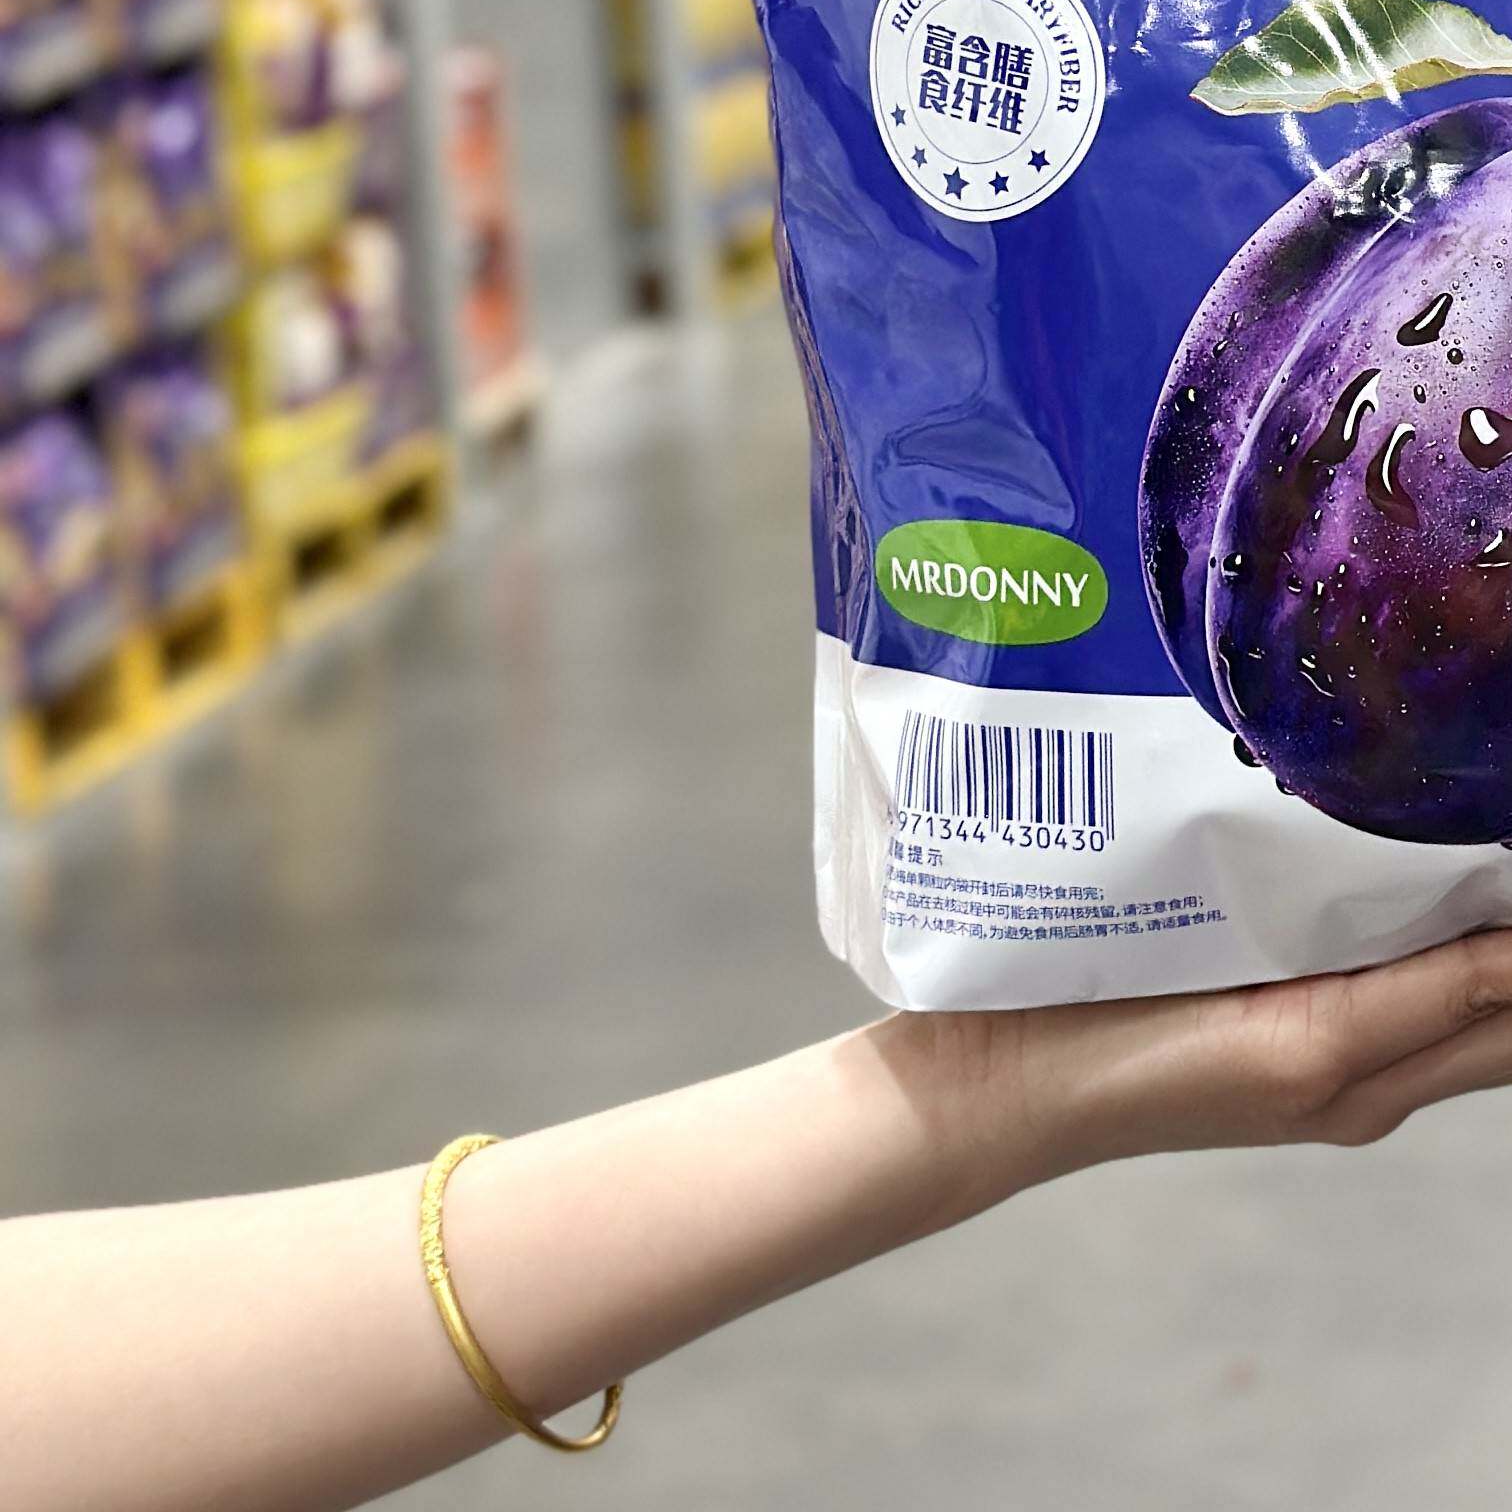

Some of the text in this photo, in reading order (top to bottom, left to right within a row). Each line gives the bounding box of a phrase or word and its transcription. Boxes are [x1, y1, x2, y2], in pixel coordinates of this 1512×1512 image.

[922, 23, 1034, 91] 富含膳
[1053, 34, 1081, 114] FIBER
[918, 69, 1027, 136] 食纤维
[891, 557, 1089, 607] MRDONNY
[1002, 824, 1105, 853] 430430
